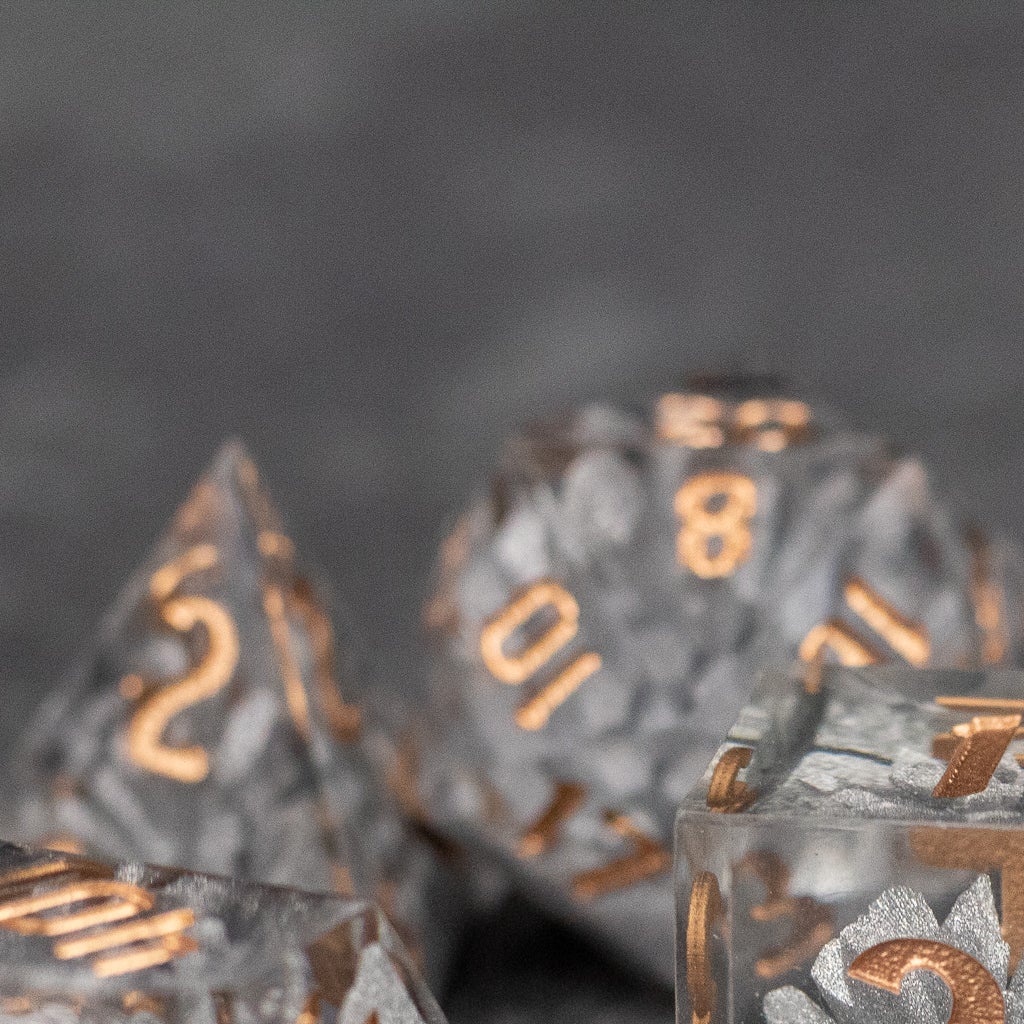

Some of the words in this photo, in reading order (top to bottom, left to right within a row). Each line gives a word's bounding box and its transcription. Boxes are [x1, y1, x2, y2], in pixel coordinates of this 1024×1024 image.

[674, 471, 759, 580] 8
[129, 595, 239, 784] 2
[479, 574, 601, 732] 10
[932, 714, 1022, 799] 1
